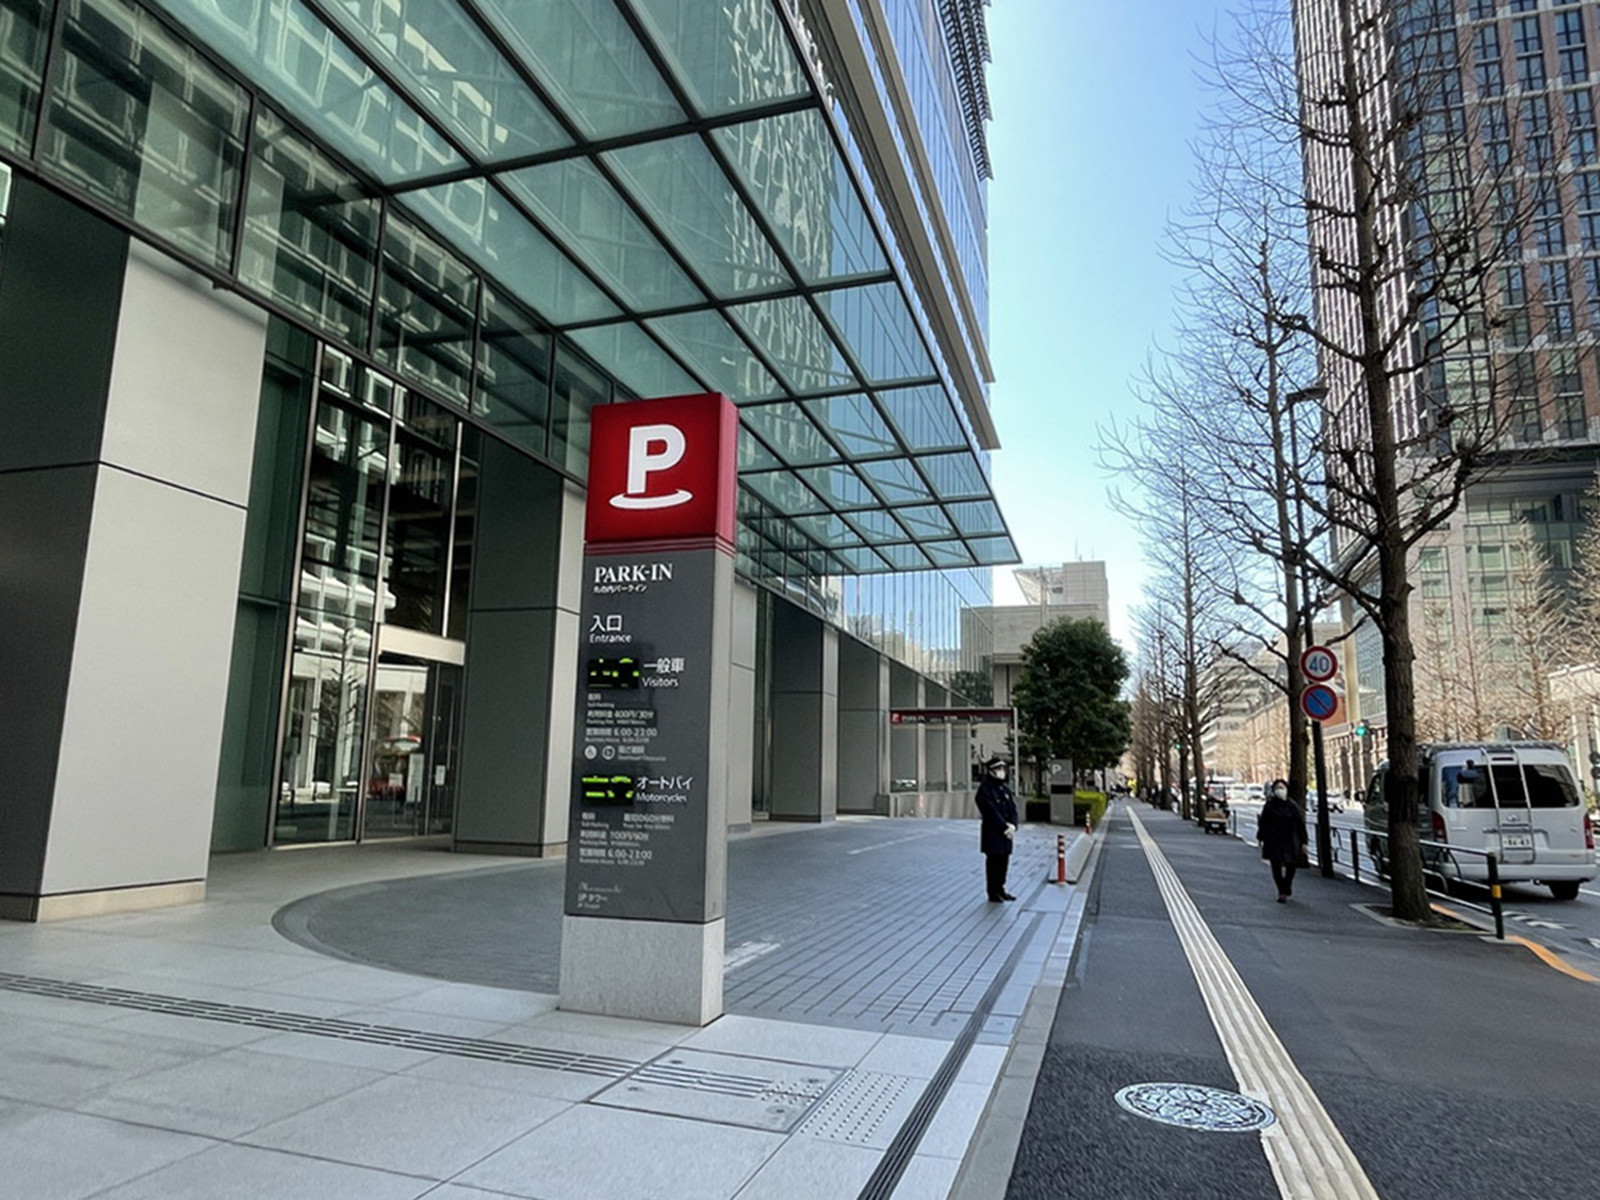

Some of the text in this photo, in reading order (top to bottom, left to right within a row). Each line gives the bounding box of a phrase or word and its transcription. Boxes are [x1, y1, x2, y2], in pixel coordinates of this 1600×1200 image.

[627, 424, 686, 495] P
[594, 563, 674, 584] PARK-IN
[589, 614, 623, 632] 入口
[589, 633, 632, 644] Entrance
[643, 657, 685, 674] 一般車
[1309, 656, 1330, 673] 40
[642, 676, 679, 687] Visitors
[1052, 763, 1062, 775] P
[636, 775, 694, 790] オートバイ
[636, 792, 687, 803] Motorcycles
